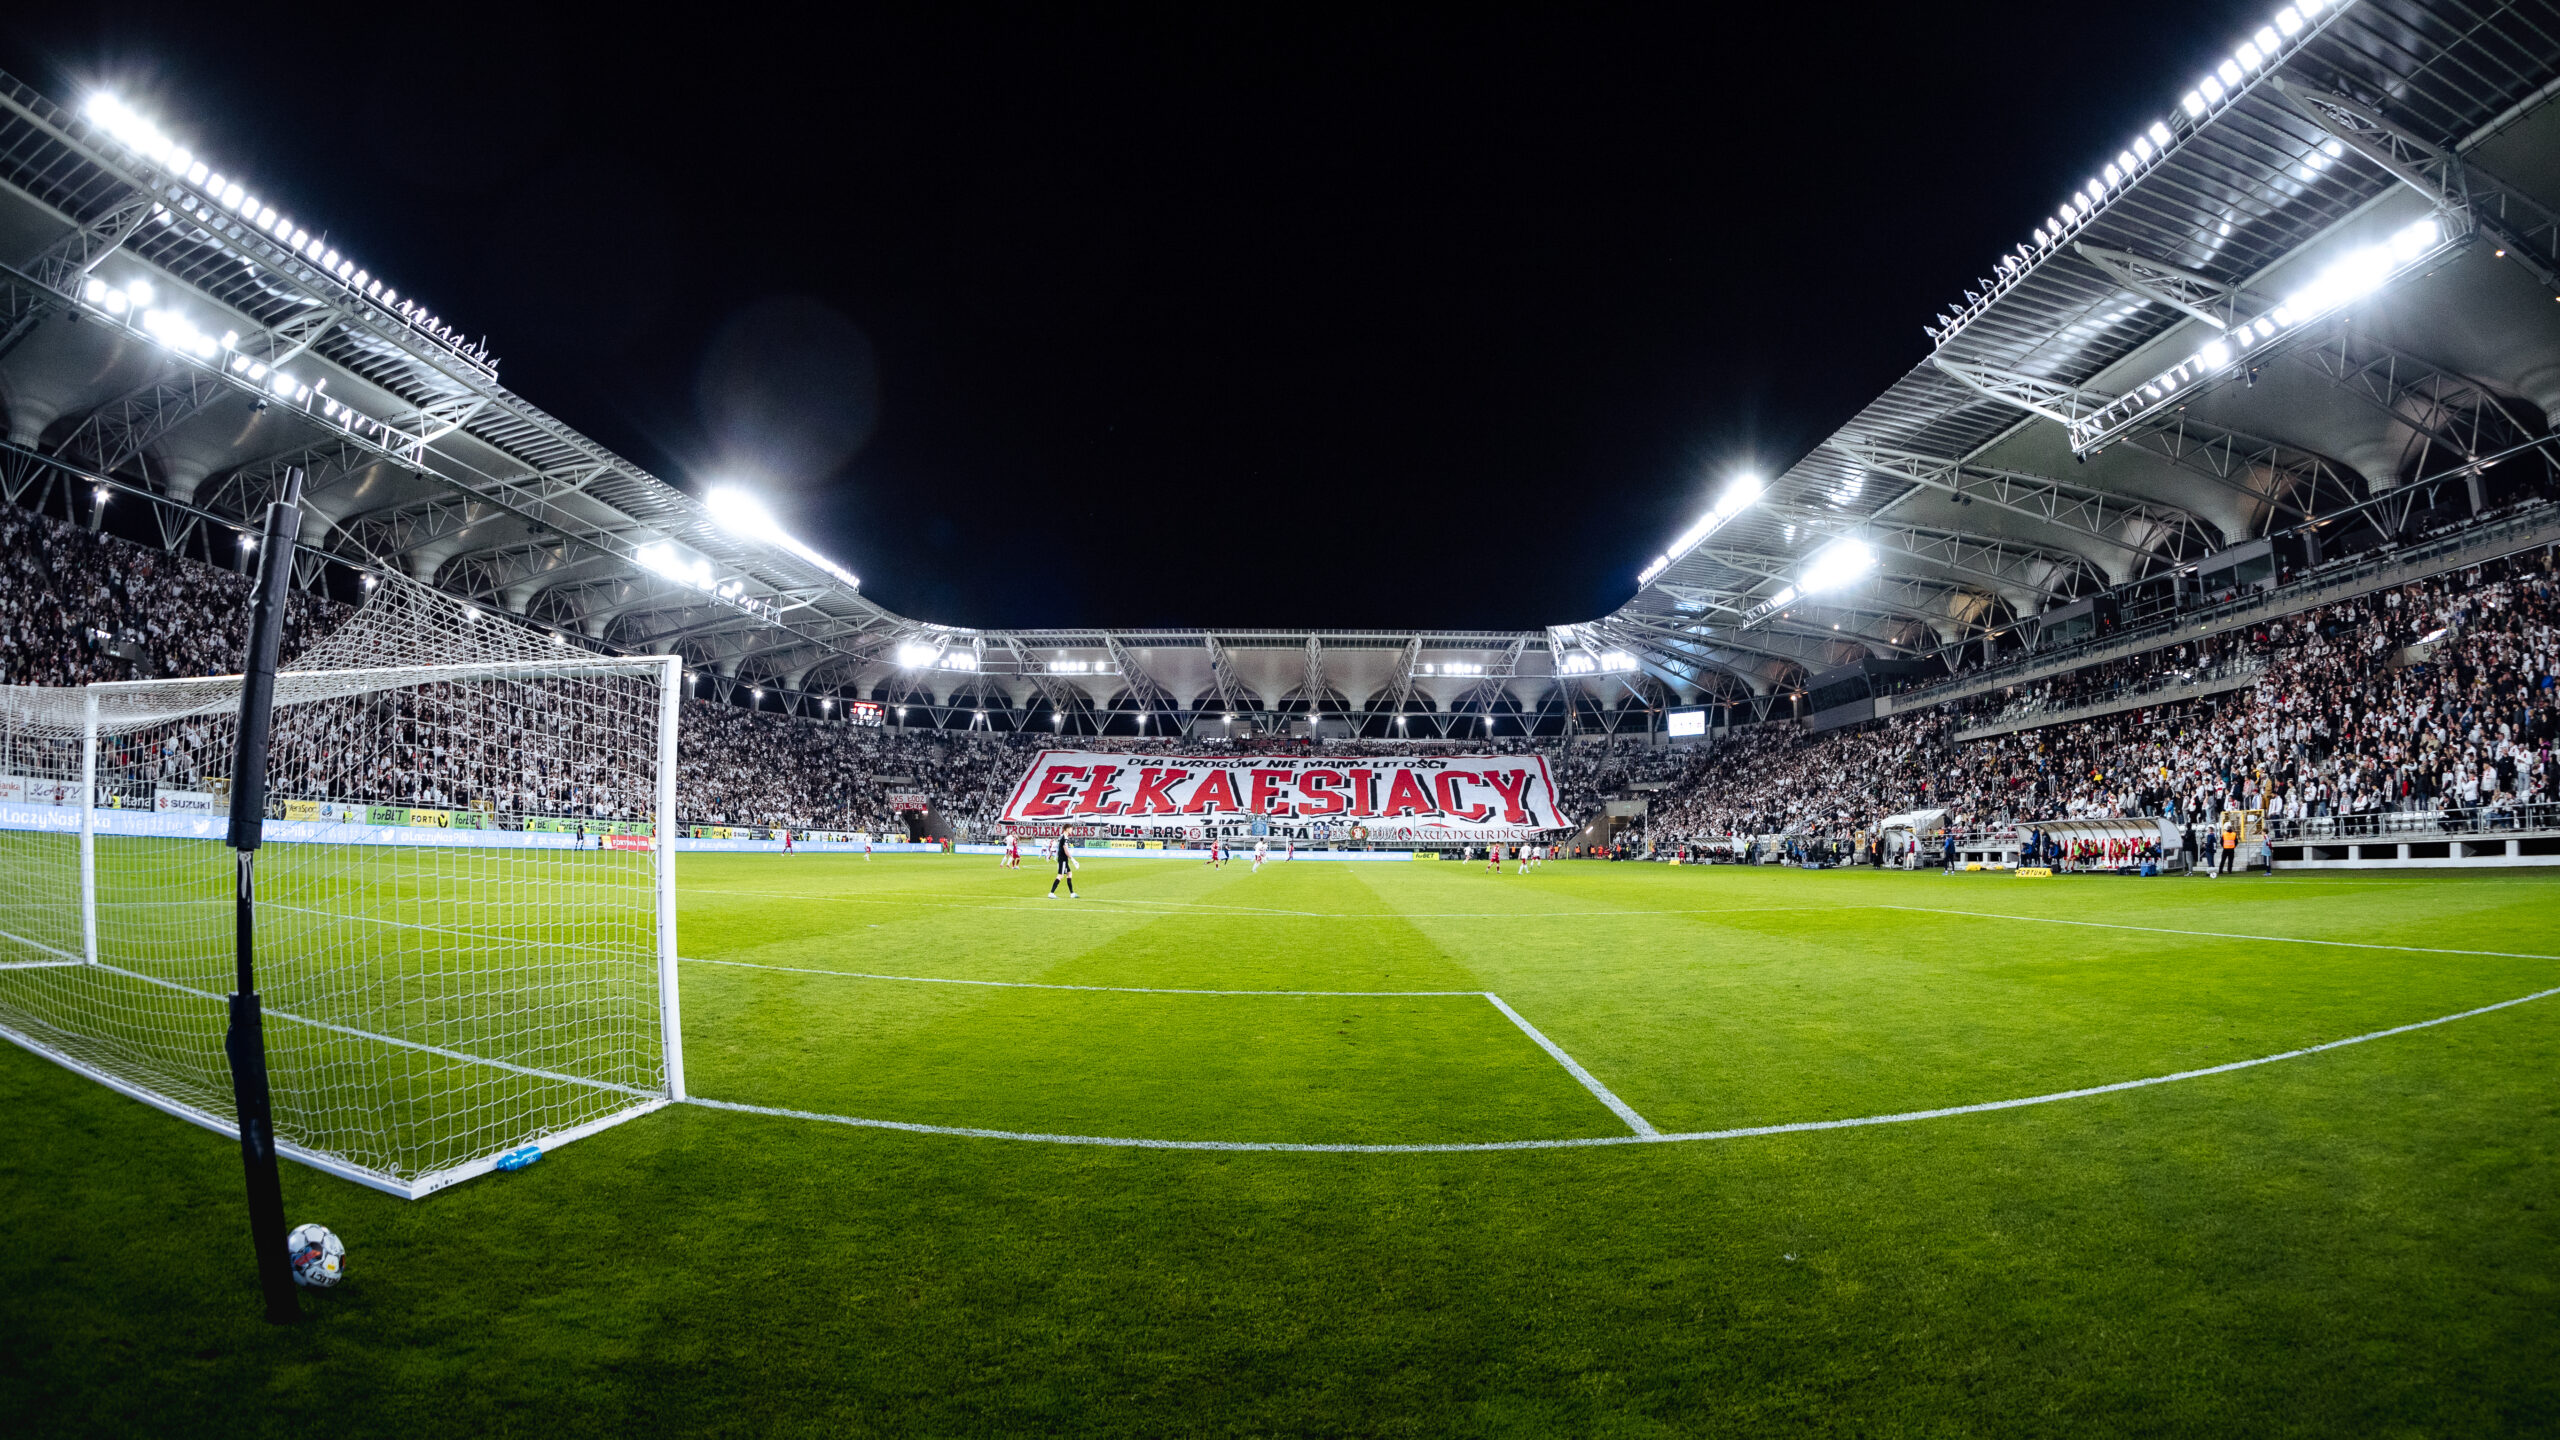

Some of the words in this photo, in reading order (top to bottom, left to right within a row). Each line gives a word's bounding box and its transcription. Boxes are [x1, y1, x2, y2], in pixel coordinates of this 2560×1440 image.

[1127, 758, 1164, 767] DLA
[1171, 758, 1263, 769] WROGÓW
[1266, 760, 1300, 769] NIE
[1303, 760, 1368, 769] MAMY
[1373, 758, 1449, 770] LITOŚCI
[1021, 764, 1530, 825] EŁKAESIACY
[170, 799, 211, 810] SUZUKI
